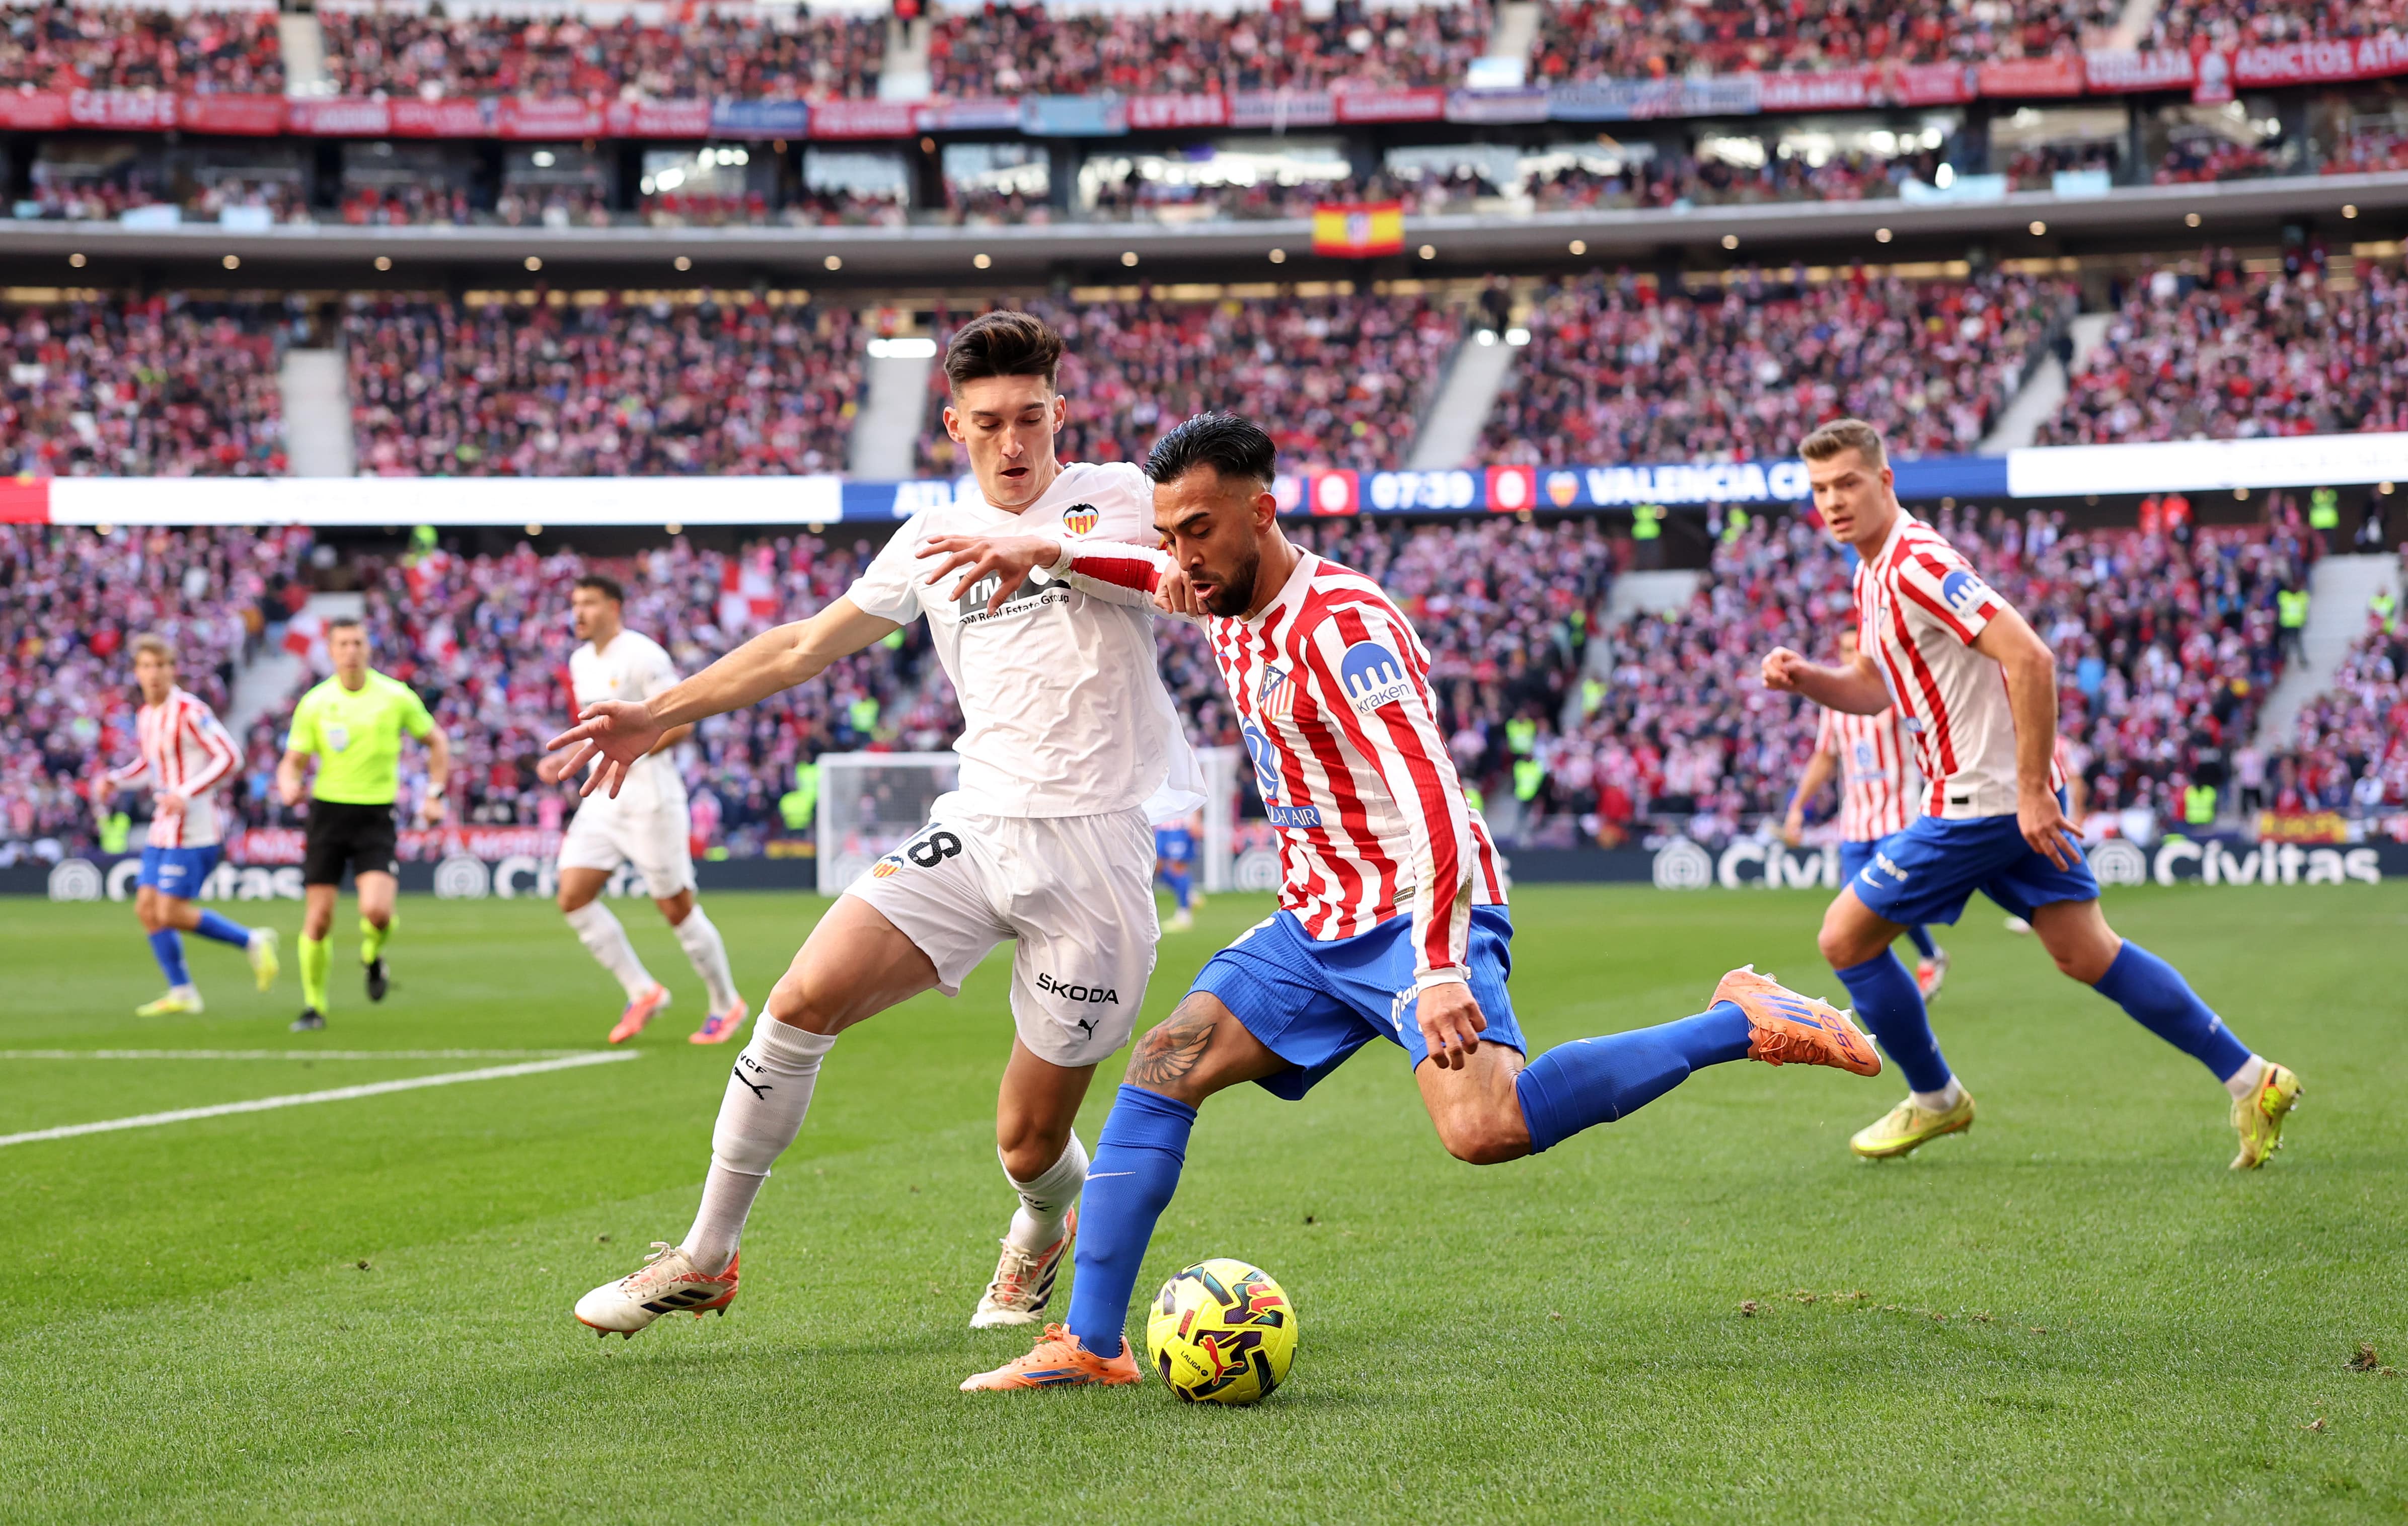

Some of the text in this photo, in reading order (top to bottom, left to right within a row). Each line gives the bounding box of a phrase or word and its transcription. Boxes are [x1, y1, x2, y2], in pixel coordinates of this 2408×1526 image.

[2235, 39, 2353, 78] ADICTOS
[1318, 474, 1348, 512] 0
[1370, 471, 1475, 510] 07:39
[1495, 470, 1526, 507] 0
[1586, 463, 1769, 505] VALENCIA
[979, 608, 1003, 622] Real
[1007, 602, 1040, 616] Estate
[1040, 594, 1070, 604] Group
[1357, 683, 1410, 714] kraken
[1292, 809, 1320, 825] AIR
[740, 1052, 768, 1074] VCF
[1180, 1350, 1201, 1372] LALIGA
